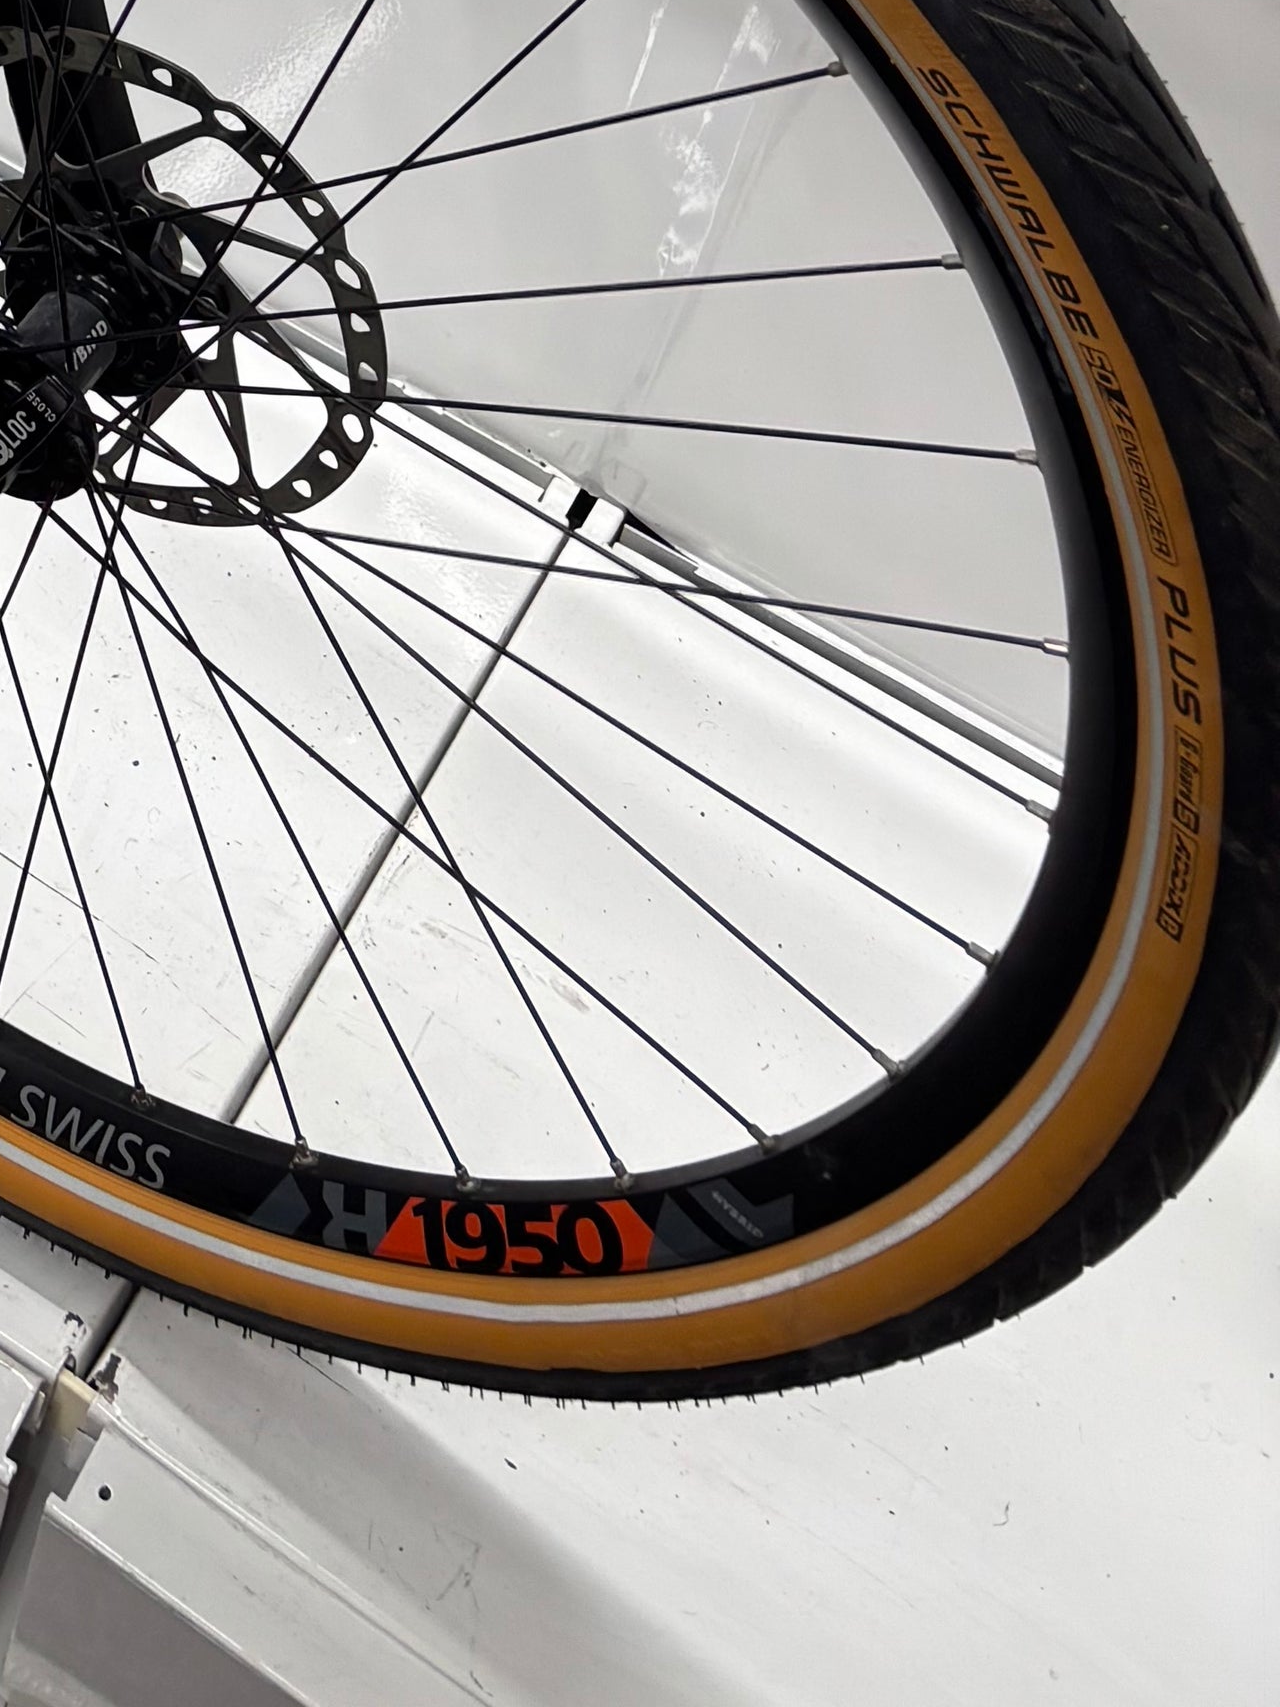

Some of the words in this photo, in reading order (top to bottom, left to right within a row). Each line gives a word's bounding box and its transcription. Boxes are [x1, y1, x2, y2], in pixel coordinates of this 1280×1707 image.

[25, 389, 57, 423] CLOSE
[917, 65, 1099, 340] SCHWALBE
[1115, 422, 1173, 559] ENERGIZER
[1157, 575, 1202, 726] PLUS
[11, 1084, 171, 1188] SWISS
[412, 1198, 627, 1277] 1950
